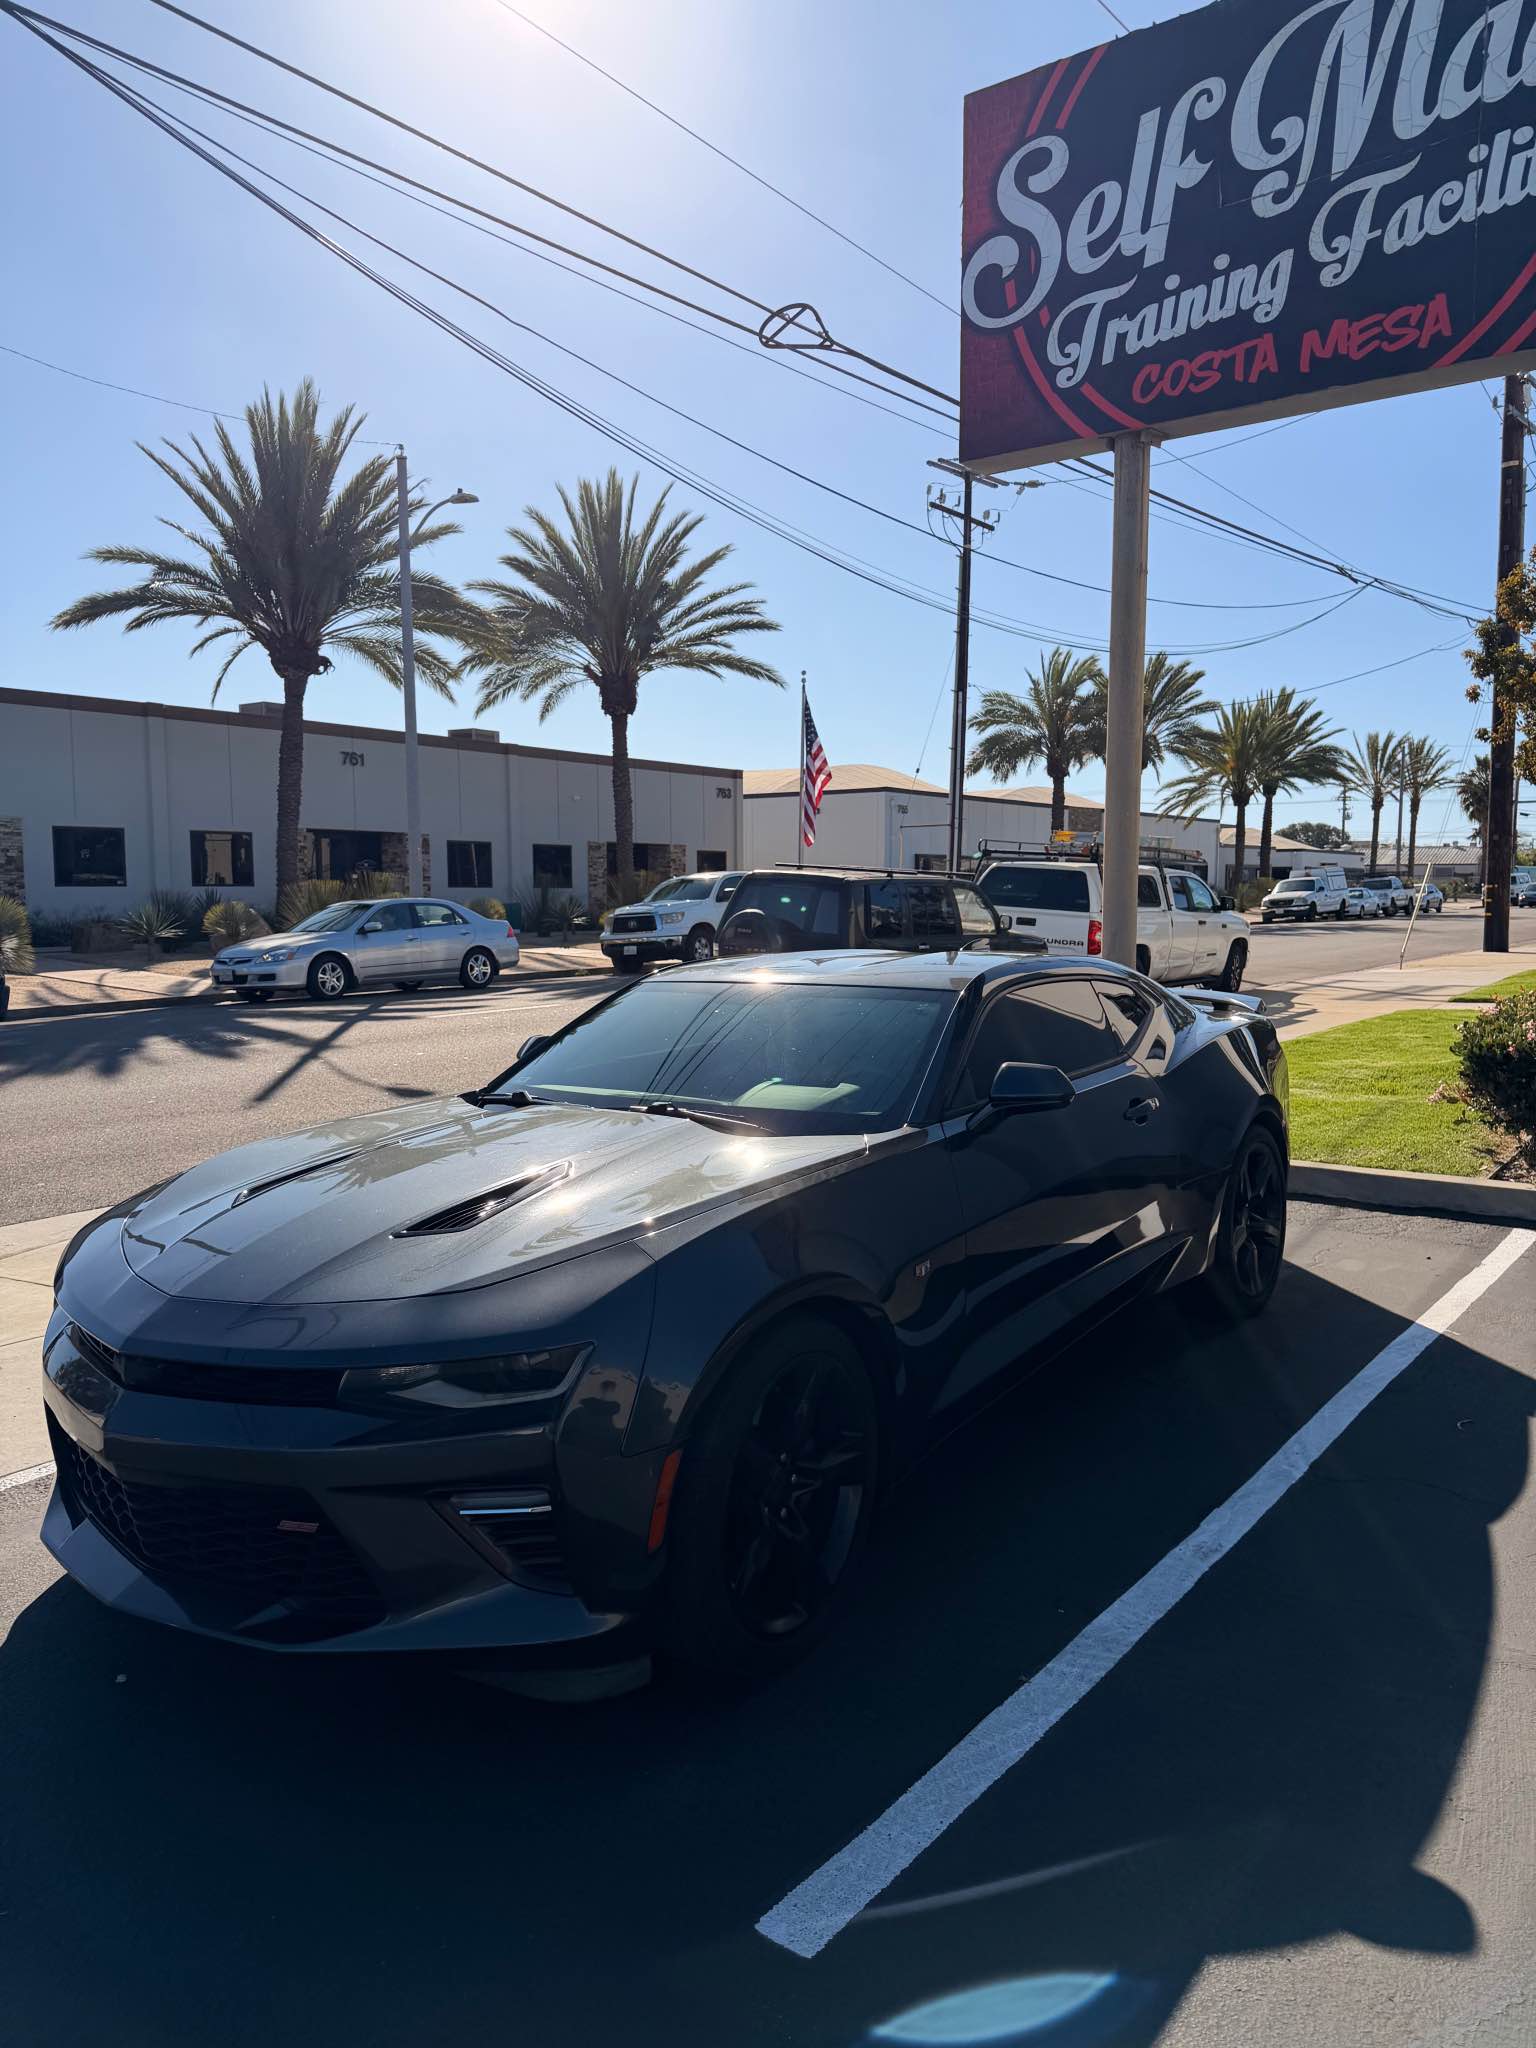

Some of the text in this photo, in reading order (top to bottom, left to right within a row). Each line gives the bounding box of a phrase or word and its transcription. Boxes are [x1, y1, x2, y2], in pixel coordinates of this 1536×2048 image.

[962, 0, 1536, 329] Self Ma
[1046, 248, 1295, 389] Training
[1132, 293, 1453, 405] COSTA MESA
[340, 751, 364, 767] 761
[715, 787, 732, 799] 763
